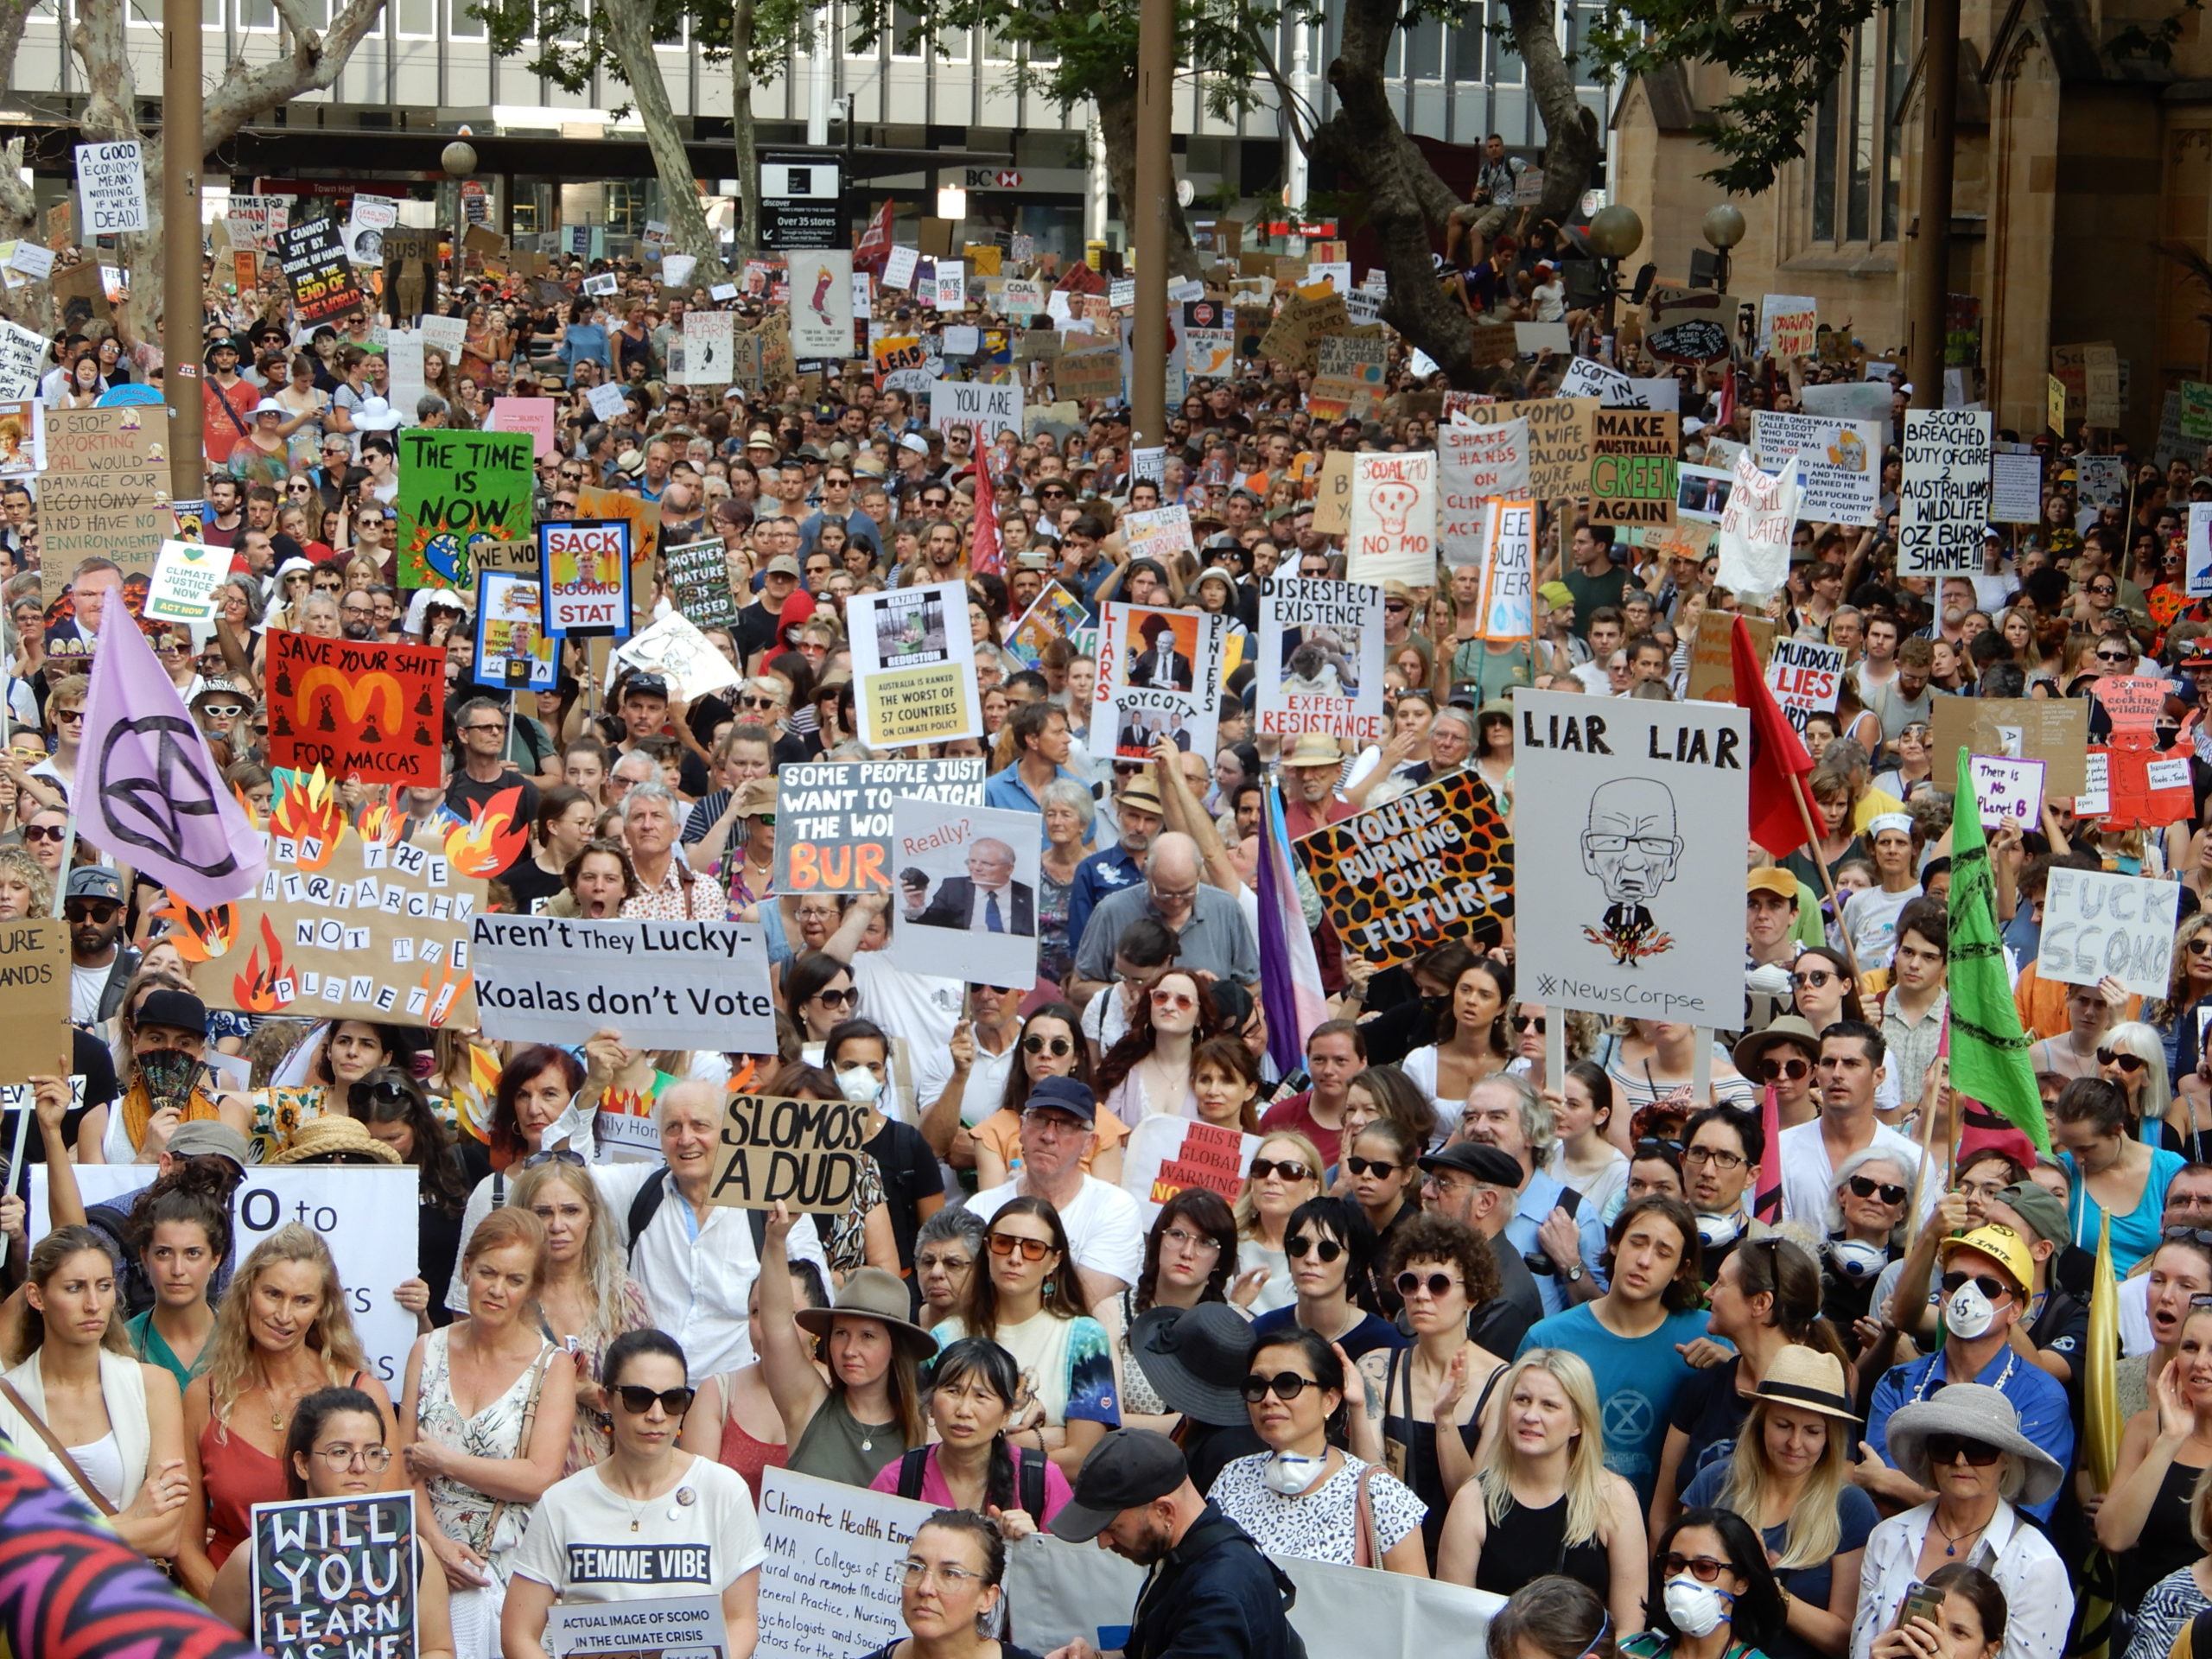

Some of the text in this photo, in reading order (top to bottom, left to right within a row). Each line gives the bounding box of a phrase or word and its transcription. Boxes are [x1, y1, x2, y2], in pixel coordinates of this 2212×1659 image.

[80, 143, 137, 163] A GOOD
[84, 161, 139, 176] ECONOMY
[98, 173, 133, 188] MEANS
[314, 182, 357, 194] Town Hall
[89, 186, 133, 199] NOTHING
[96, 200, 105, 209] IF
[229, 198, 260, 208] TIME
[762, 199, 791, 207] discover
[94, 207, 141, 229] DEAD!
[777, 217, 836, 226] Over 35 stores
[279, 217, 331, 245] I CANNOT
[289, 242, 308, 257] SIT
[384, 241, 429, 260] BUSH
[283, 255, 321, 276] DRINK IN
[297, 263, 340, 288] FOR THE
[296, 272, 346, 303] END OF
[938, 278, 962, 290] YOU'RE
[1007, 283, 1036, 294] COAL
[322, 288, 360, 314] WORLD
[7, 327, 44, 356] Demand
[875, 346, 922, 375] LEAD
[1320, 349, 1333, 362] ON
[1334, 350, 1342, 362] A
[1319, 361, 1357, 377] PLANET
[1611, 380, 1634, 401] IN
[954, 388, 1013, 416] YOU ARE
[67, 413, 111, 432] STOP
[1596, 415, 1665, 438] MAKE
[1758, 413, 1834, 428] THERE ONCE WAS
[1758, 421, 1818, 434] CALLED SCOTT
[1924, 410, 1976, 427] SCOMO
[1450, 429, 1507, 448] SHAKE
[1760, 429, 1782, 437] WHO
[1906, 423, 1986, 447] BREACHED
[404, 435, 529, 472] THE TIME
[1594, 438, 1674, 455] AUSTRALIA
[1759, 437, 1821, 450] THINK WAS
[1780, 446, 1799, 454] HOT
[87, 454, 143, 472] WOULD
[1458, 446, 1518, 467] HANDS
[1904, 447, 1942, 464] DUTY
[41, 473, 156, 493] DAMAGE OUR
[454, 471, 478, 493] IS
[1473, 472, 1498, 487] ON
[1590, 454, 1678, 501] GREEN
[1808, 478, 1842, 487] DENIED
[1810, 470, 1857, 480] AND THEN
[1940, 466, 1952, 480] 2
[41, 493, 143, 512] ECONOMY
[1825, 490, 1860, 500] FUCKED
[417, 493, 512, 530] NOW
[1592, 502, 1668, 523] AGAIN
[1808, 499, 1872, 513] OUR COUNTRY
[1916, 500, 1985, 523] WILDLIFE
[44, 514, 156, 532] AND HAVE NO
[549, 531, 621, 554] SACK
[1900, 524, 1933, 548] OZ
[669, 547, 725, 569] MOTHER
[163, 575, 213, 593] JUSTICE
[165, 566, 216, 582] CLIMATE
[673, 565, 726, 586] NATURE
[172, 587, 200, 601] NOW
[696, 585, 709, 598] IS
[887, 593, 925, 606] HAZARD
[1262, 575, 1380, 607] DISRESPECT
[159, 602, 204, 616] ACT NOW
[683, 599, 728, 619] PISSED
[1274, 601, 1365, 626] EXISTENCE
[276, 633, 442, 677] SAVE YOUR SHIT
[886, 651, 942, 667] REDUCTION
[1773, 640, 1844, 673] MURDOCH
[877, 674, 955, 691] AUSTRALIA RANKED
[1776, 666, 1834, 700] LIES
[880, 687, 955, 706] THE WORST OF
[1287, 695, 1356, 714] EXPECT
[1783, 696, 1815, 709] ARE
[880, 702, 957, 723] 57 COUNTRIES
[881, 720, 958, 738] ON CLIMATE POLICY
[1262, 710, 1381, 740] RESISTANCE
[1522, 710, 1742, 771] LIAR LIAR
[292, 741, 420, 775] FOR MACCAS
[783, 760, 983, 787] SOME PEOPLE JUST
[1980, 765, 2005, 778] There
[1990, 781, 2006, 795] No
[782, 787, 893, 812] WANT TO
[794, 816, 840, 841] THE
[902, 818, 972, 857] Really?
[1338, 819, 1463, 887] BURNING
[1384, 857, 1446, 899] OUR
[2048, 870, 2177, 925] FUCK
[1360, 871, 1509, 952] FUTURE
[297, 921, 467, 968] NOT THE
[473, 918, 635, 956] Aren't They
[474, 979, 771, 1018] Koalas don't Vote
[1187, 1125, 1243, 1150] THIS IS
[1178, 1145, 1241, 1174] GLOBAL
[710, 1147, 857, 1206] A DUD
[1159, 1163, 1240, 1196] WARMING
[763, 1488, 882, 1541] Climate Health
[270, 1503, 397, 1554] WILL
[571, 1548, 708, 1580] FEMME VIBE
[865, 1562, 880, 1579] of
[273, 1548, 399, 1606] YOU
[793, 1572, 815, 1588] and
[275, 1599, 400, 1643] LEARN
[563, 1609, 710, 1630] ACTUAL IMAGE OF SCOMO
[575, 1630, 704, 1649] IN THE CLIMATE CRISIS
[831, 1630, 852, 1645] and
